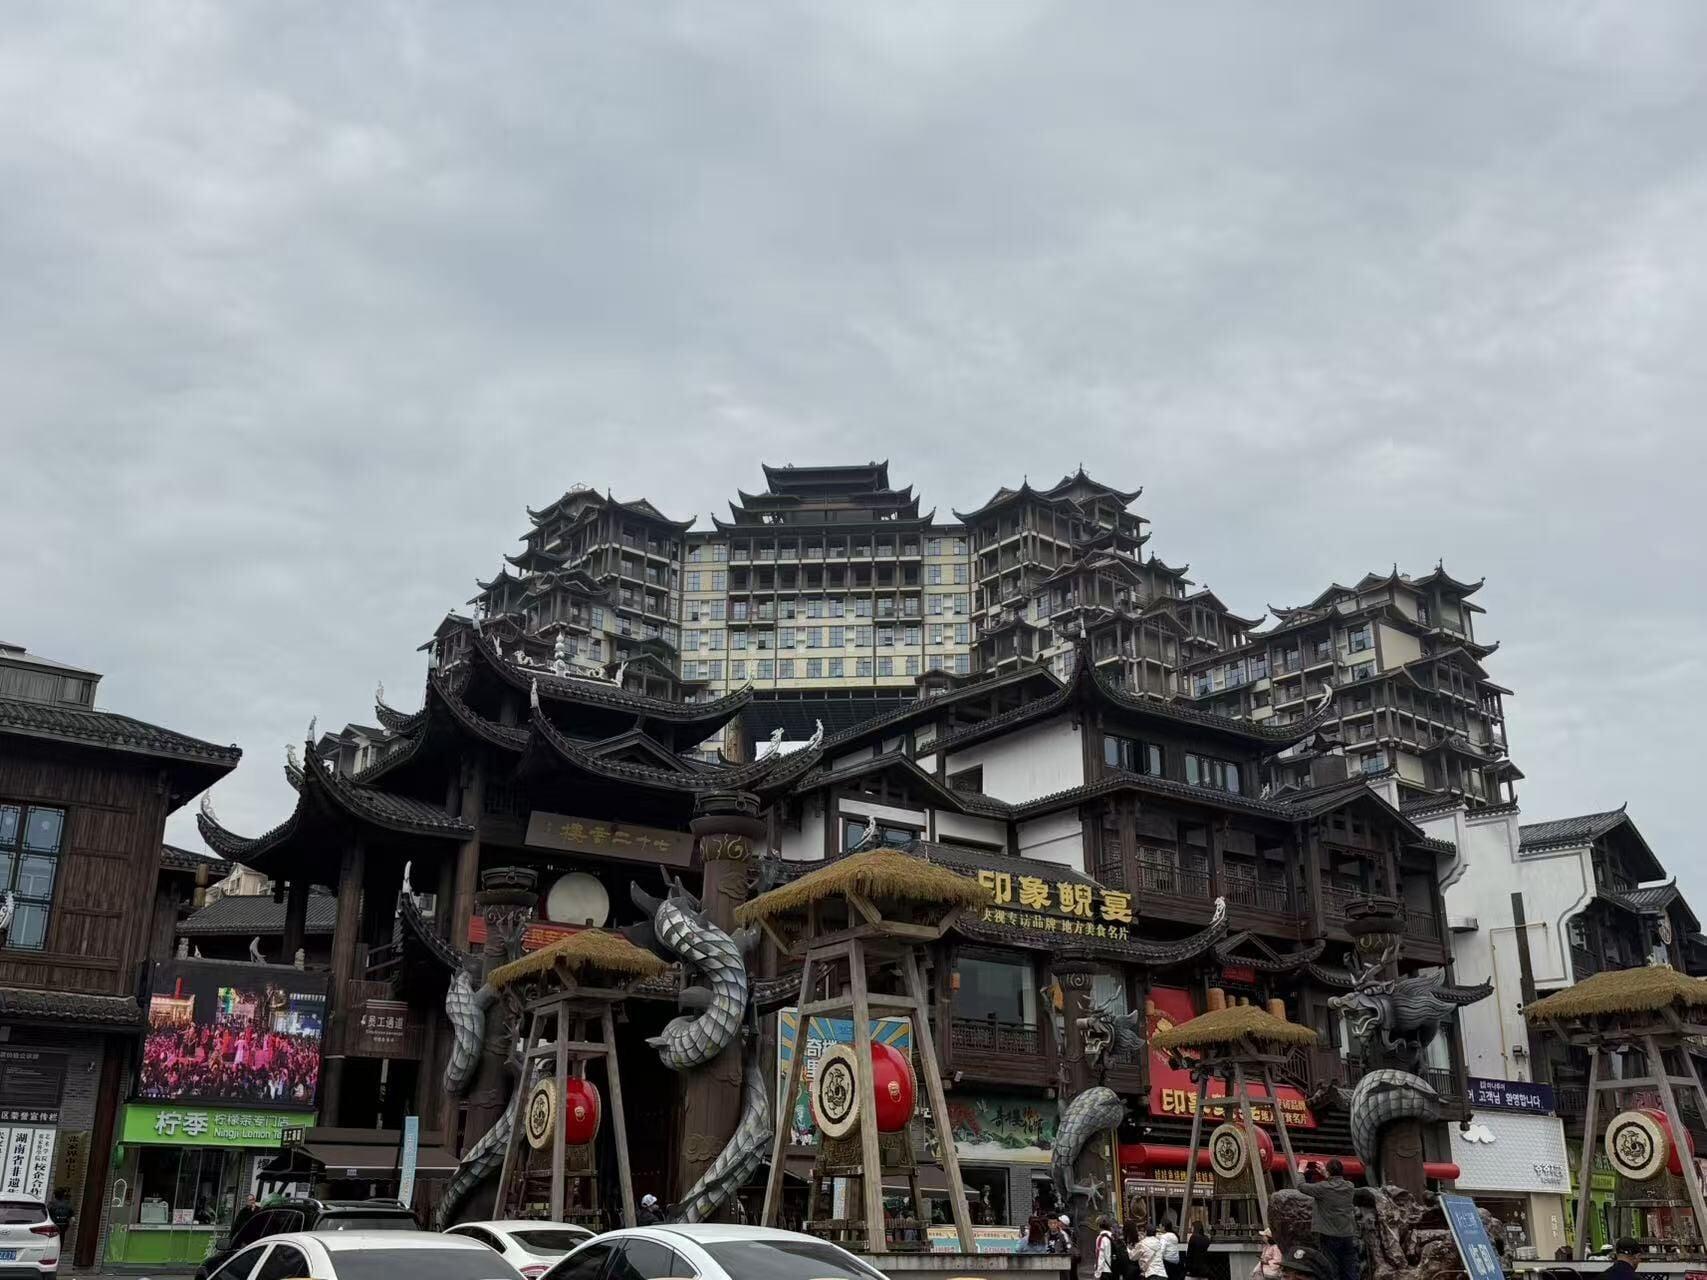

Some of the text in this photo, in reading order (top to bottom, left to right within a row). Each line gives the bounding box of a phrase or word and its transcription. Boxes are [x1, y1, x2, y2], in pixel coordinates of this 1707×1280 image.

[978, 869, 1133, 923] 印象鲵宴
[1062, 919, 1129, 941] 地方美食名片
[1479, 1090, 1501, 1105] 고객님
[1505, 1092, 1544, 1109] 환영합니다.
[155, 1110, 209, 1137] 柠季
[214, 1113, 289, 1128] 柠檬茶专门店
[214, 1127, 239, 1139] Ningji
